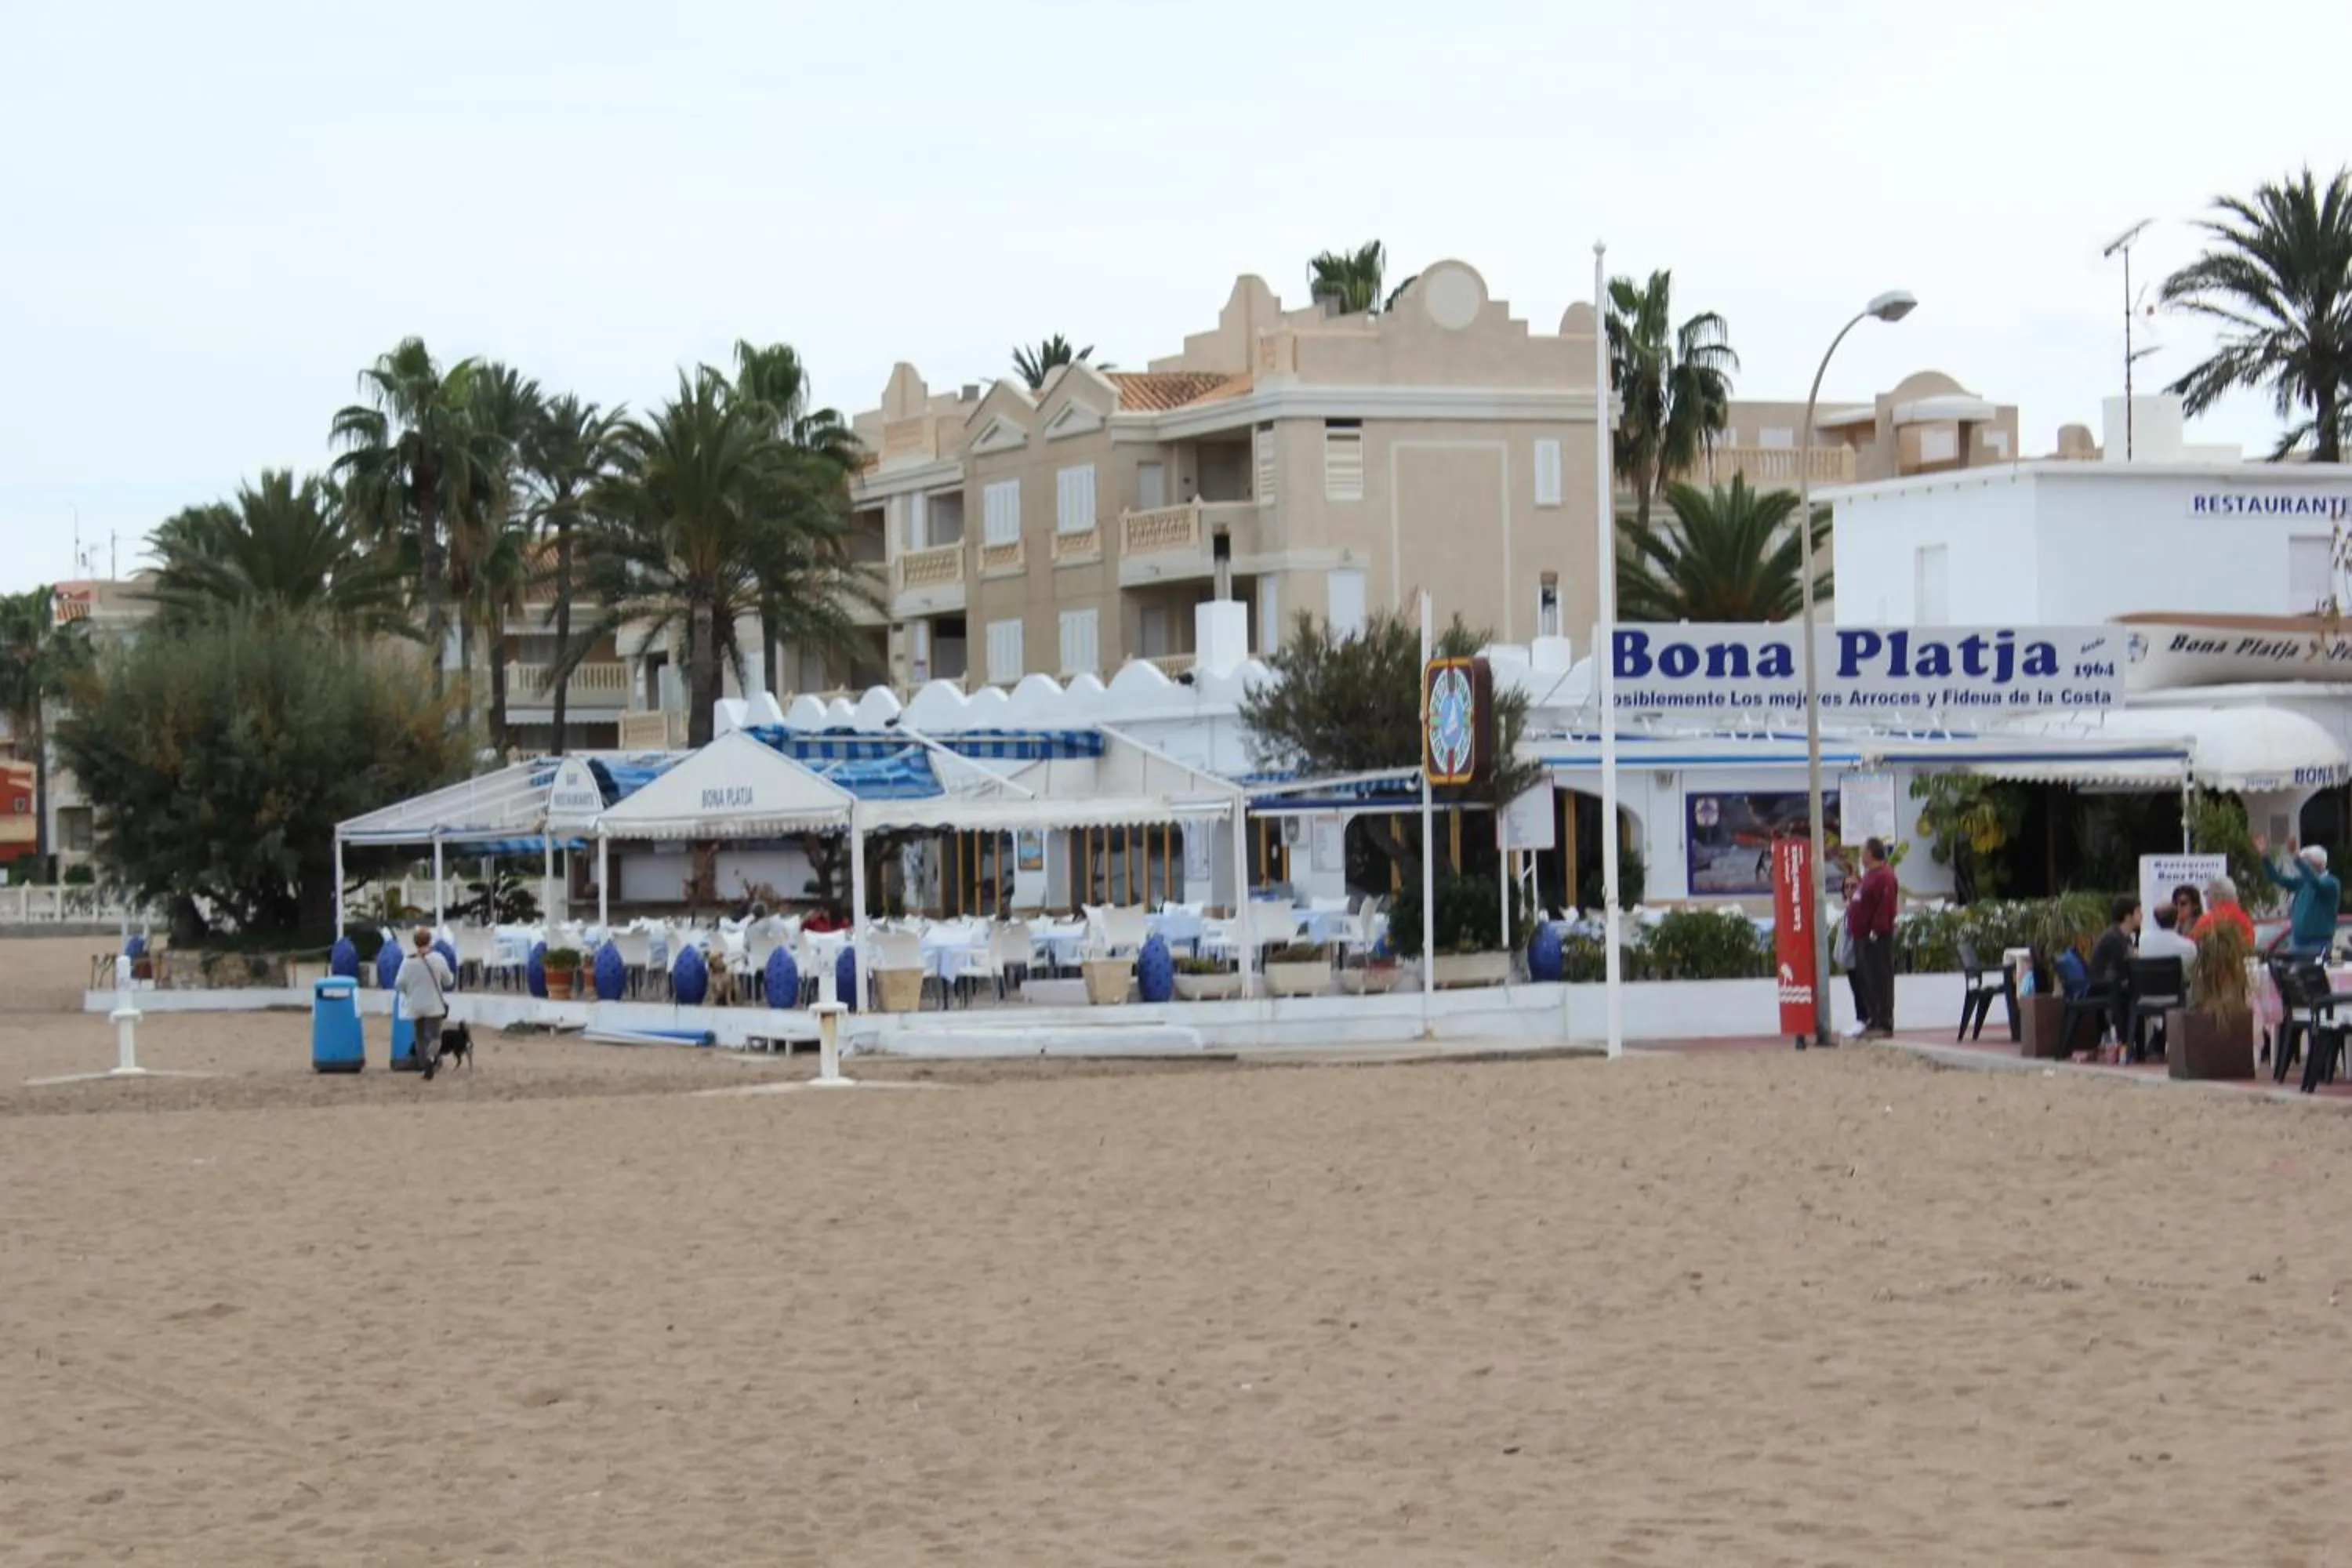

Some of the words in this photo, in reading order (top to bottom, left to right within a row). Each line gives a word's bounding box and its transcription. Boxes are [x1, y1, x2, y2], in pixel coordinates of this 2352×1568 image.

[2169, 633, 2228, 652] Bona
[1613, 630, 1795, 679] Bona
[1836, 630, 2060, 683] Platja
[1599, 690, 1725, 706] osiblemente
[1730, 690, 1762, 706] Los
[1849, 690, 1920, 706] Arroces
[1927, 691, 1936, 709] y
[2009, 688, 2030, 704] de
[2038, 689, 2053, 704] la
[2061, 688, 2111, 704] Costa
